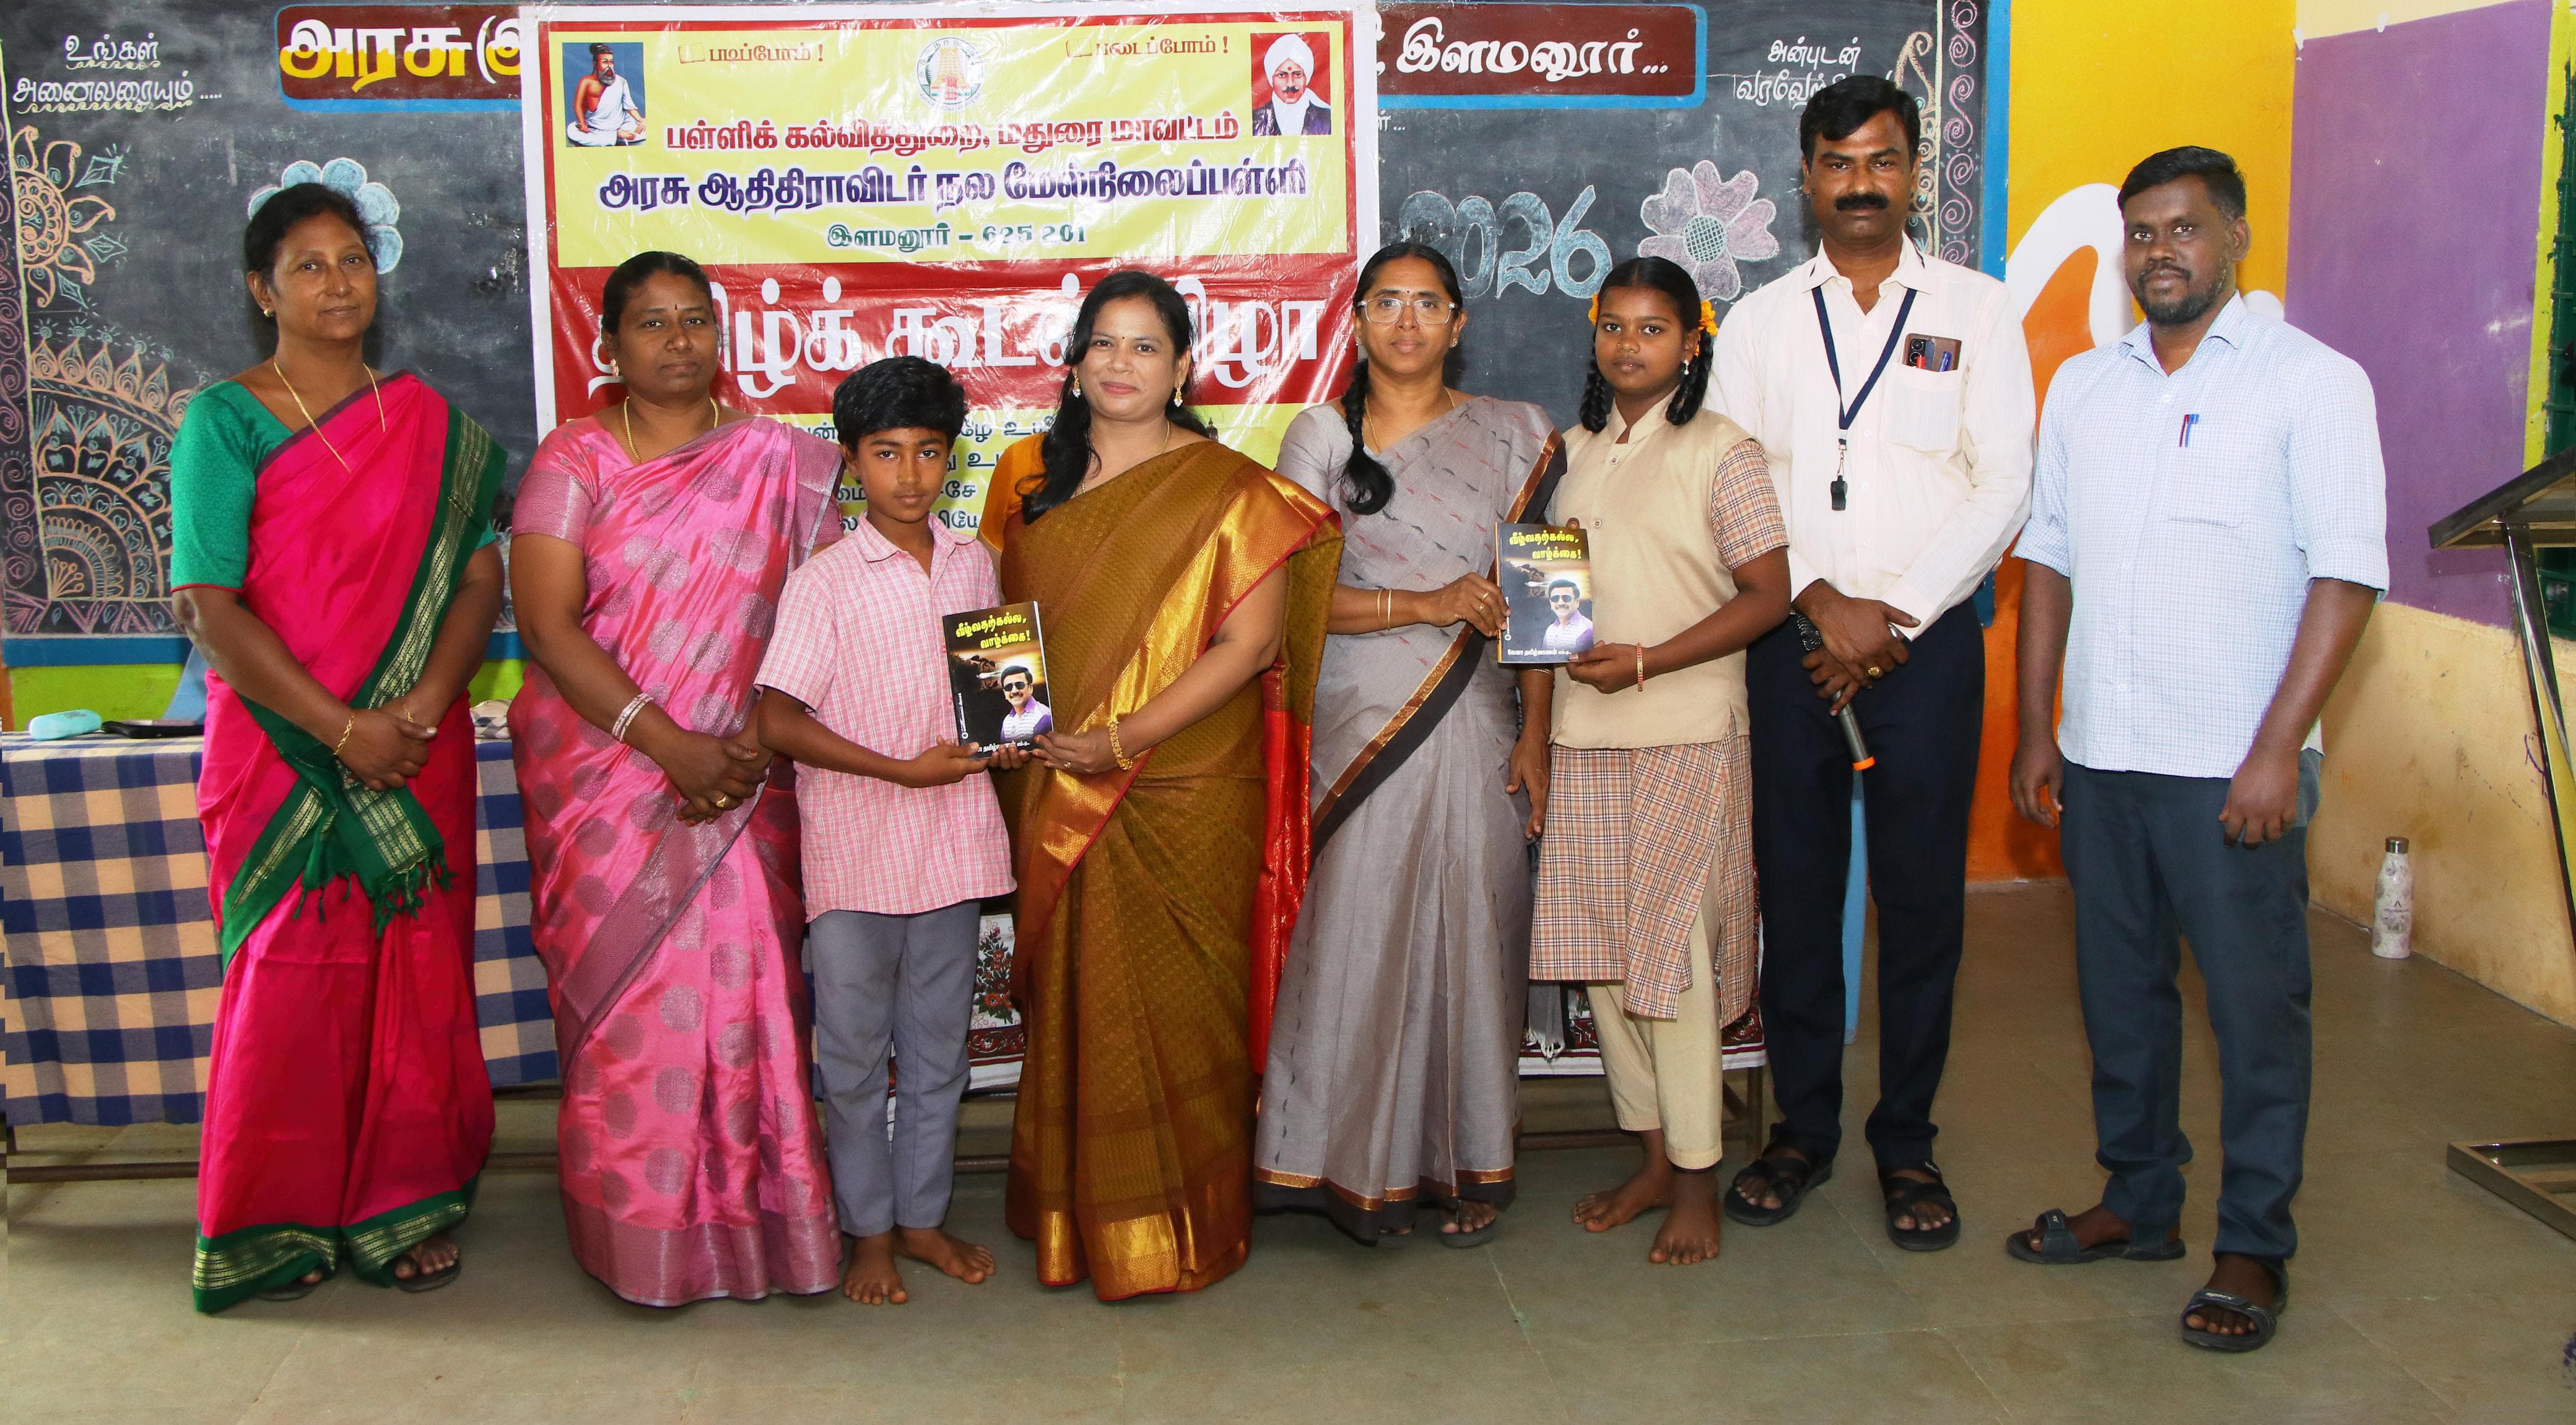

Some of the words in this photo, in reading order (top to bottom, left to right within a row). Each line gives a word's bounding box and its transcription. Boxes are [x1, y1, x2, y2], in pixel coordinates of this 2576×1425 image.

[65, 32, 159, 61] உங்கள்
[709, 43, 811, 64] படிப்போம்
[1096, 35, 1216, 55] படைப்போம்
[1767, 36, 1861, 73] அன்புடன்
[667, 120, 778, 149] பள்ளிக்
[785, 119, 991, 157] கல்வித்துறை,
[998, 121, 1103, 154] மதுரை
[1111, 110, 1239, 142] மாவட்டம்
[599, 173, 690, 212] அரசு
[698, 165, 927, 217] ஆதிதிராவிடர்
[936, 172, 996, 213] நல
[1004, 157, 1307, 204] மேல்நிலைப்பள்ளி
[828, 222, 951, 252] இளமனூர்
[983, 225, 1033, 244] 625
[1042, 224, 1087, 244] 201
